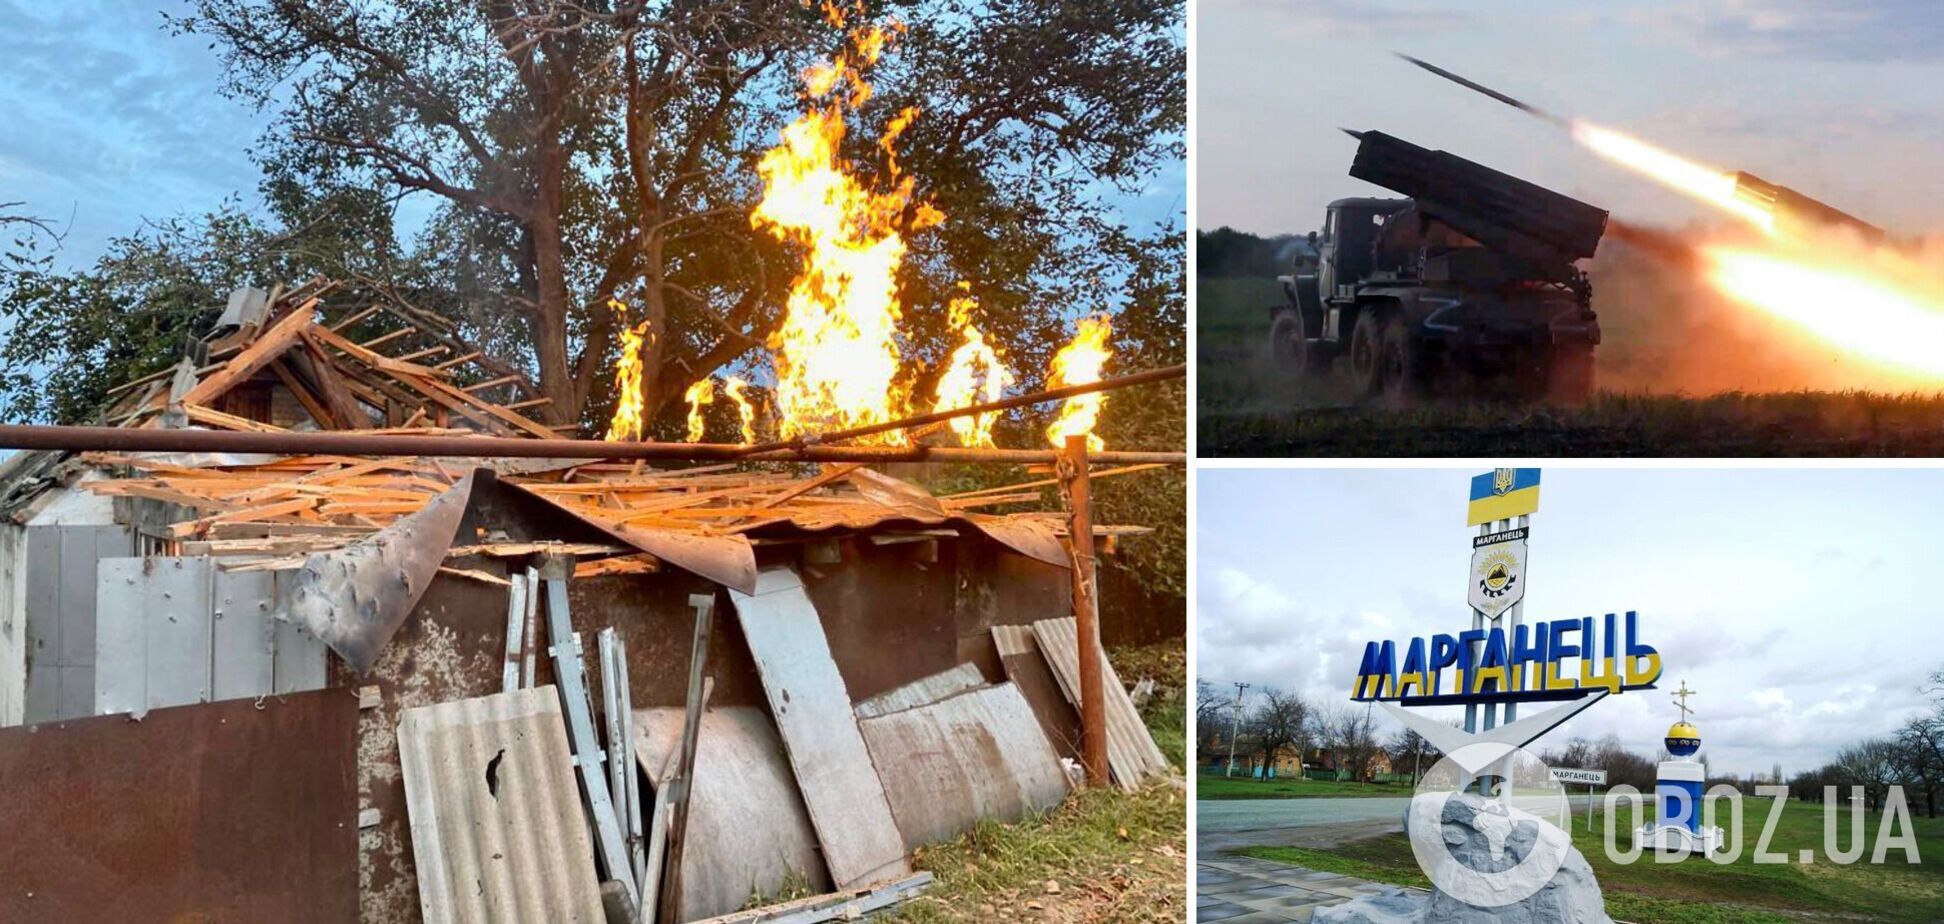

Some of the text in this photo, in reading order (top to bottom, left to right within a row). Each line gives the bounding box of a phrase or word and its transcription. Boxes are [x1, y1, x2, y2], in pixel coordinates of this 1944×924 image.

[1476, 530, 1524, 545] МАРГАНЕЦЬ
[1351, 611, 1664, 698] МАРГАНЕЦЬ
[1552, 771, 1601, 781] МАРГАНЕЦЬ
